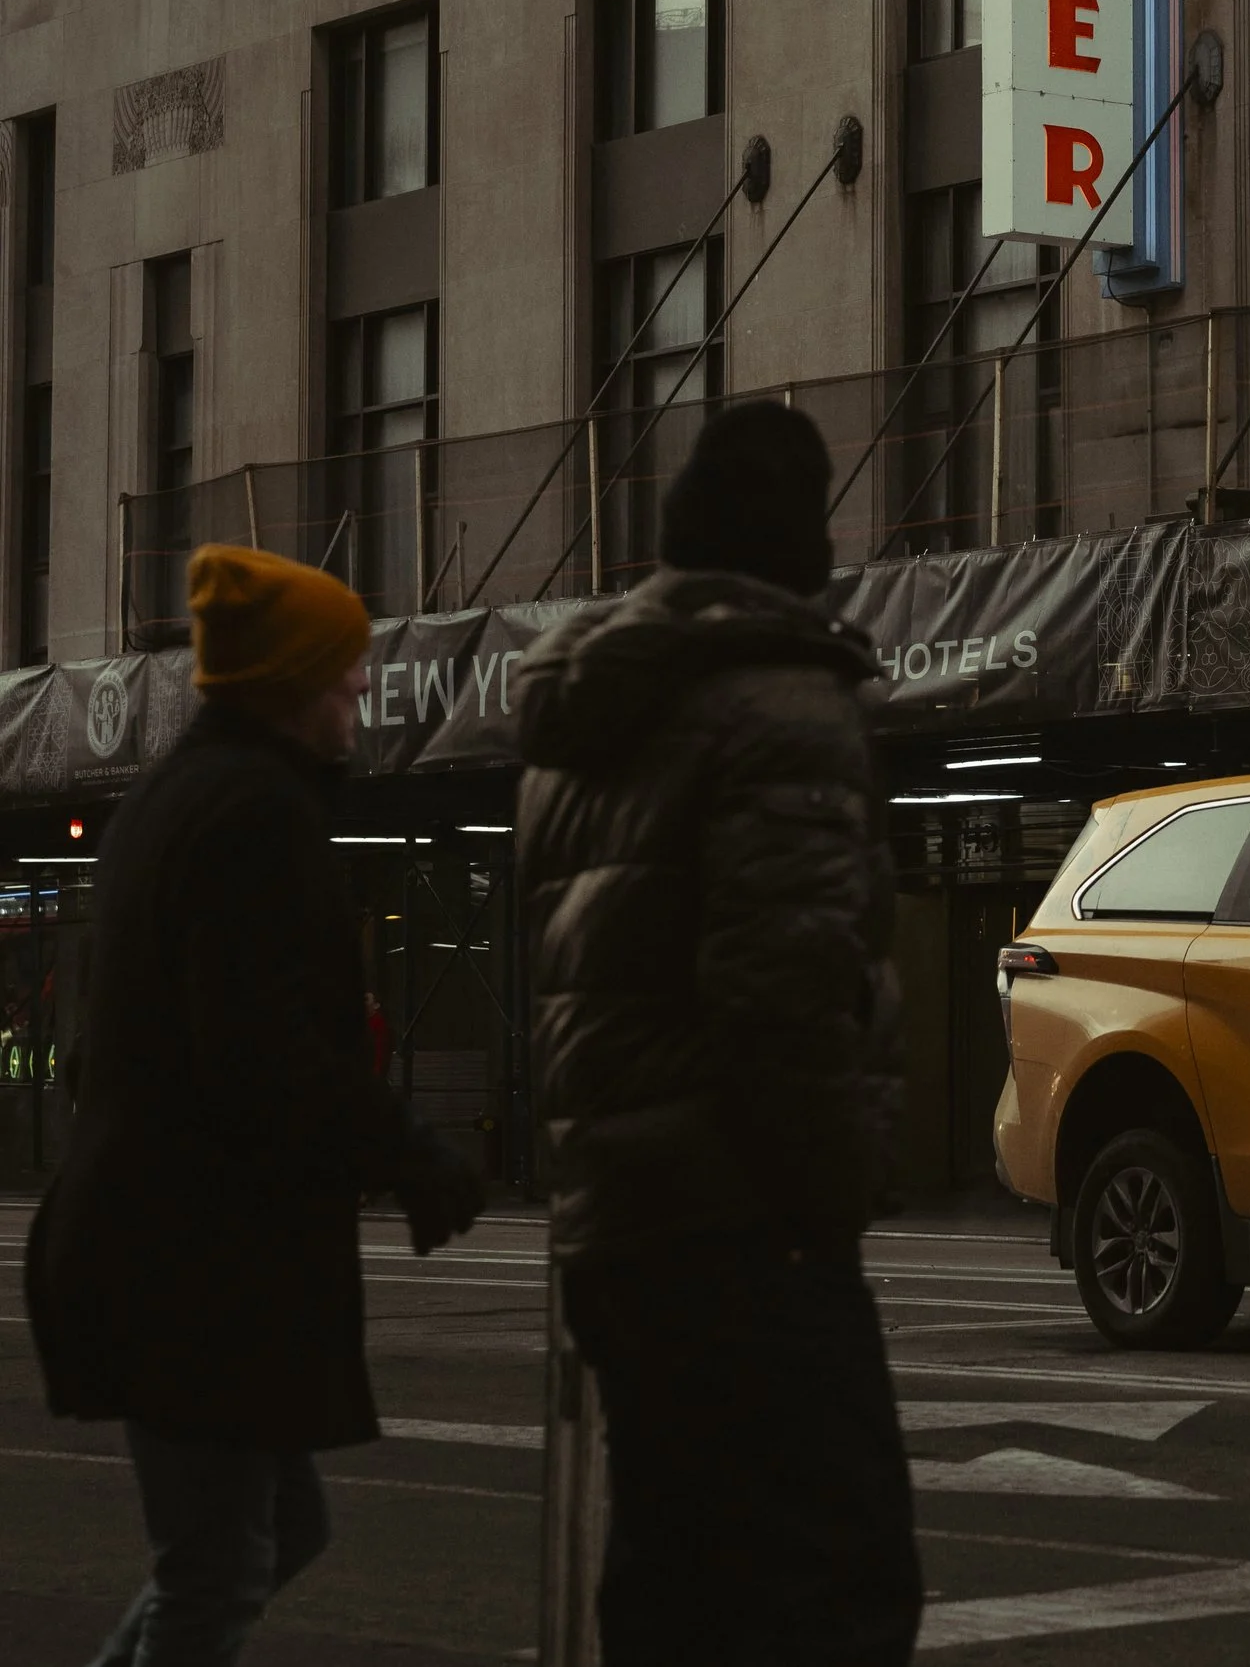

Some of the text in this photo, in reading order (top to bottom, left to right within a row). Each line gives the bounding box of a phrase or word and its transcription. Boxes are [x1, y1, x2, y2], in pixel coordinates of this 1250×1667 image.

[873, 630, 1038, 681] HOTELS
[74, 767, 103, 780] BUTCHER
[111, 764, 140, 775] BANKER
